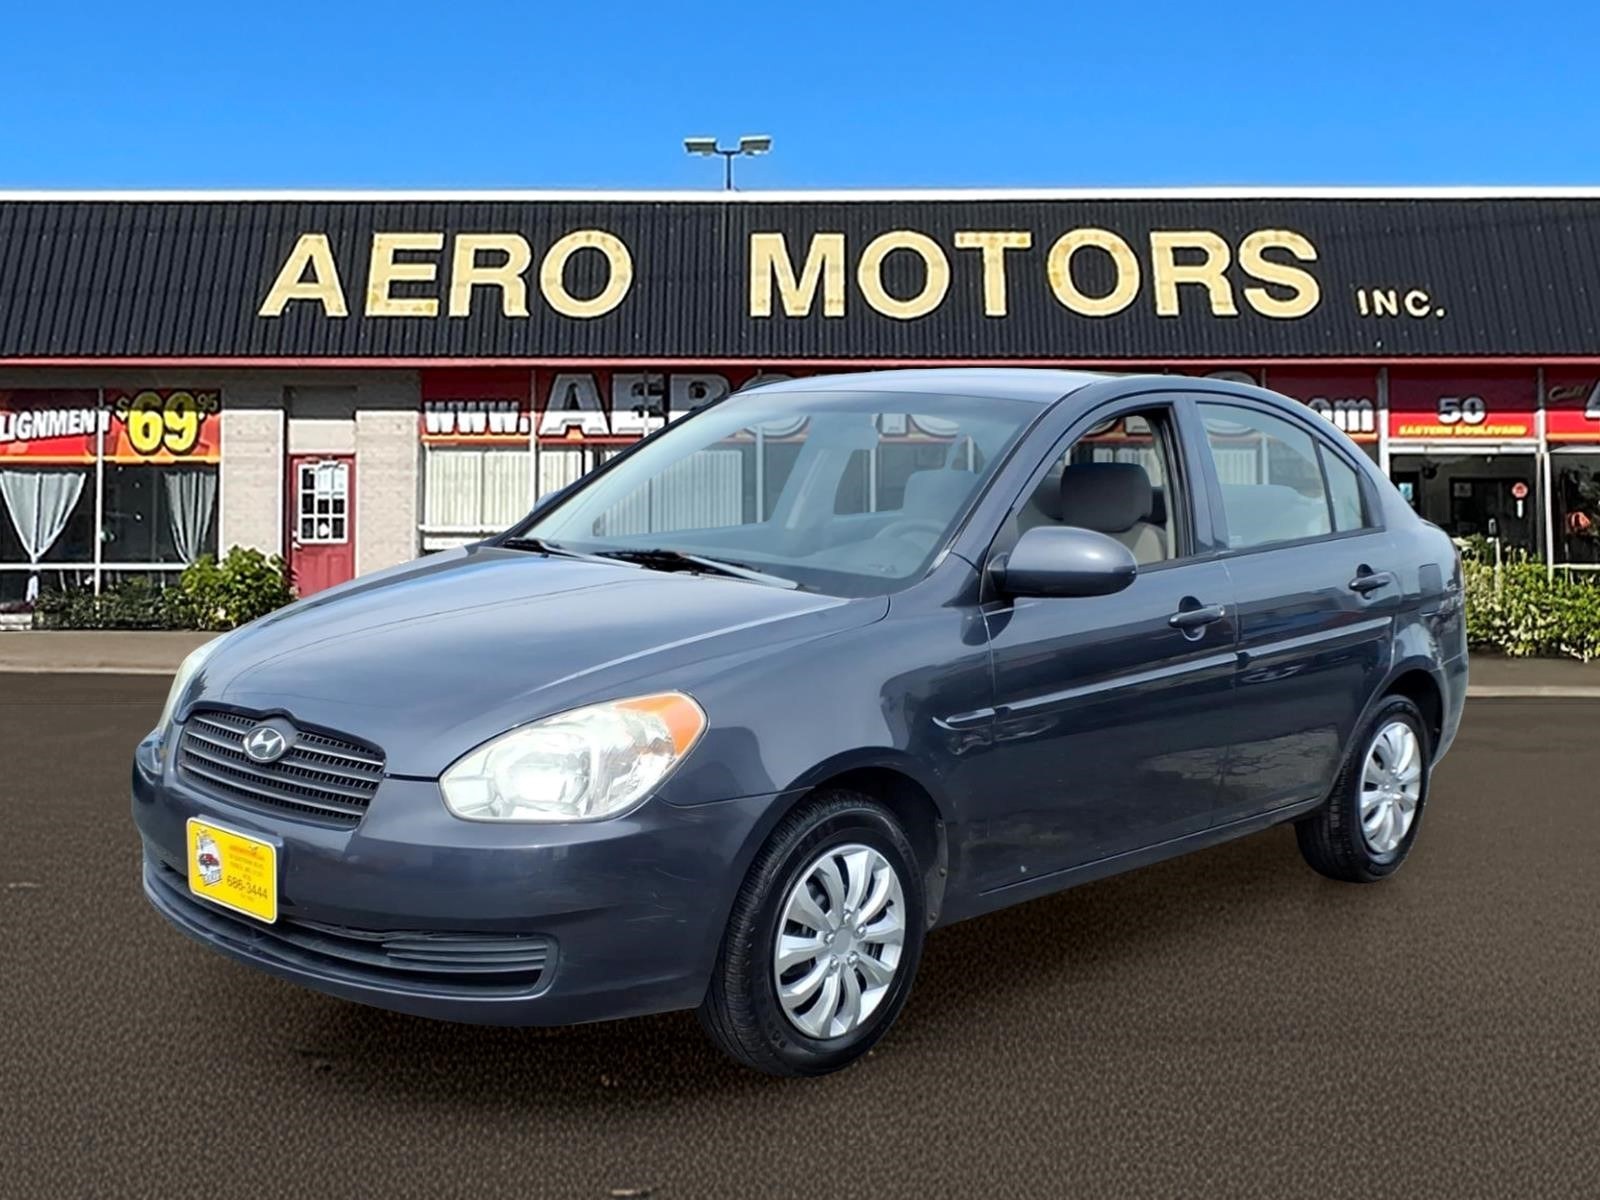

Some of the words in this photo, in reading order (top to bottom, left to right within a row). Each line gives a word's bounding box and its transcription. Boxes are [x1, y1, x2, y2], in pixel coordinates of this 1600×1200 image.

[257, 229, 634, 319] AERO
[749, 228, 1321, 319] MOTORS
[1356, 288, 1447, 318] INC.
[1438, 397, 1485, 424] 50
[1399, 425, 1454, 436] EASTERN
[1455, 425, 1528, 436] BOULEVARD
